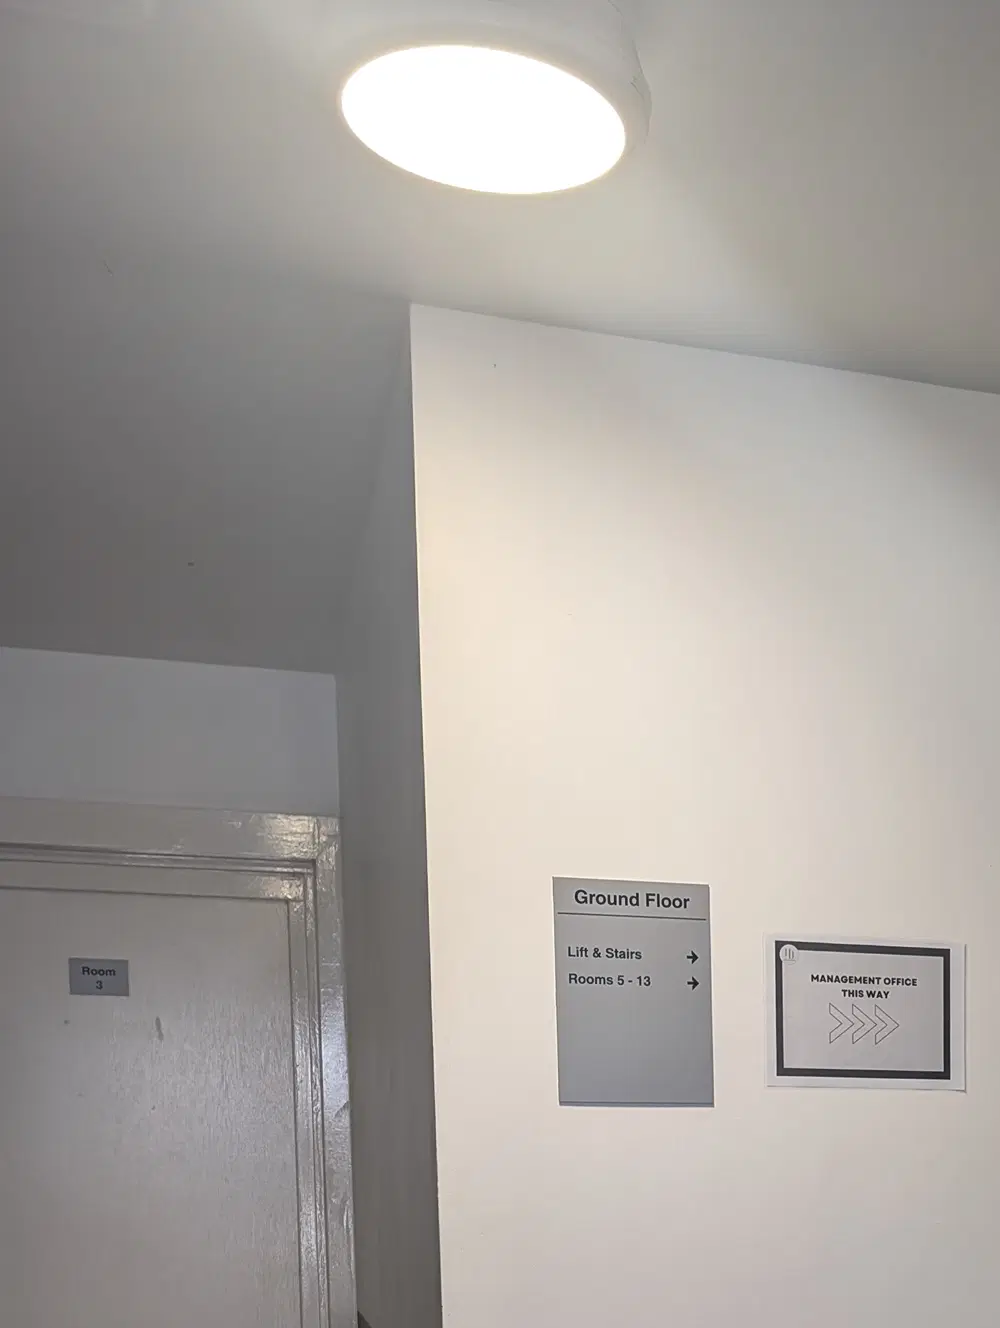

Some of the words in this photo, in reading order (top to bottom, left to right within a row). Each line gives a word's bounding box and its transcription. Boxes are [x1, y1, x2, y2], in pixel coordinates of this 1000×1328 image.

[574, 890, 640, 906] Ground
[645, 893, 690, 908] Floor
[568, 946, 588, 957] Lift
[592, 948, 601, 958] &
[605, 948, 642, 960] Stairs
[81, 966, 116, 976] Room
[95, 980, 103, 990] 3
[568, 973, 613, 985] Rooms
[617, 975, 624, 986] 5
[636, 975, 651, 986] 13
[811, 974, 881, 985] MANAGEMENT
[883, 977, 918, 986] OFFICE
[841, 989, 864, 998] THIS
[866, 990, 890, 999] WAY
